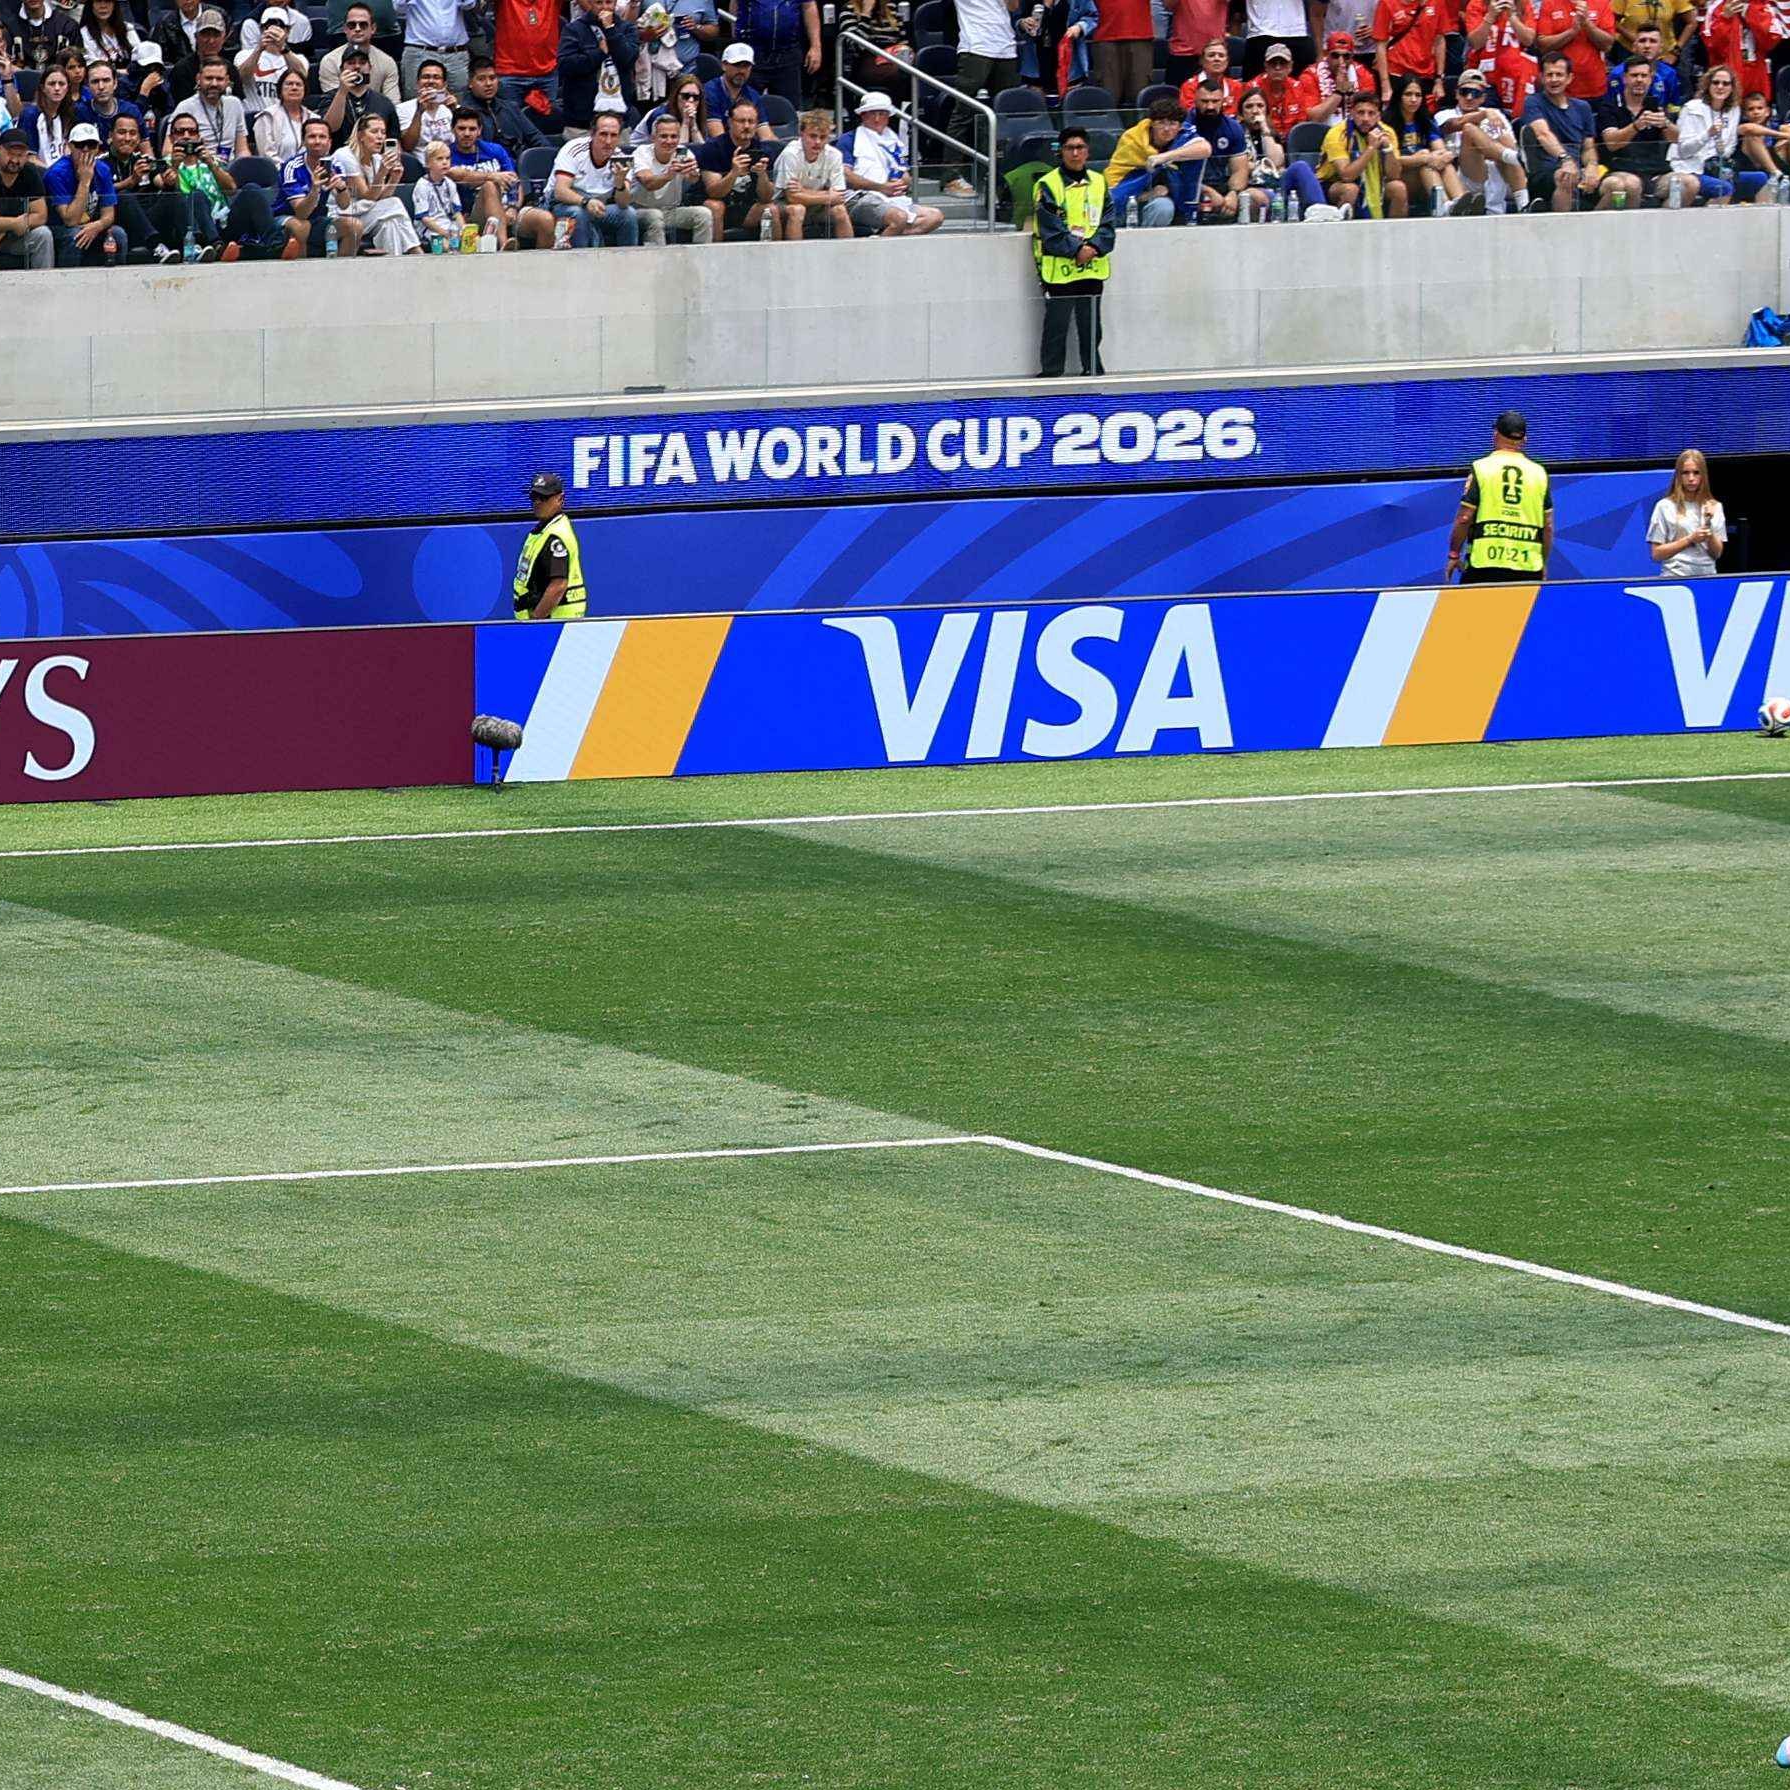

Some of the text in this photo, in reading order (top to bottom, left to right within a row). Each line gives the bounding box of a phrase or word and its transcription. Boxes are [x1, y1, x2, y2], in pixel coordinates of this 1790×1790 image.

[571, 406, 1258, 488] FIFA WORLD CUP 2026
[821, 604, 1234, 763] VISA
